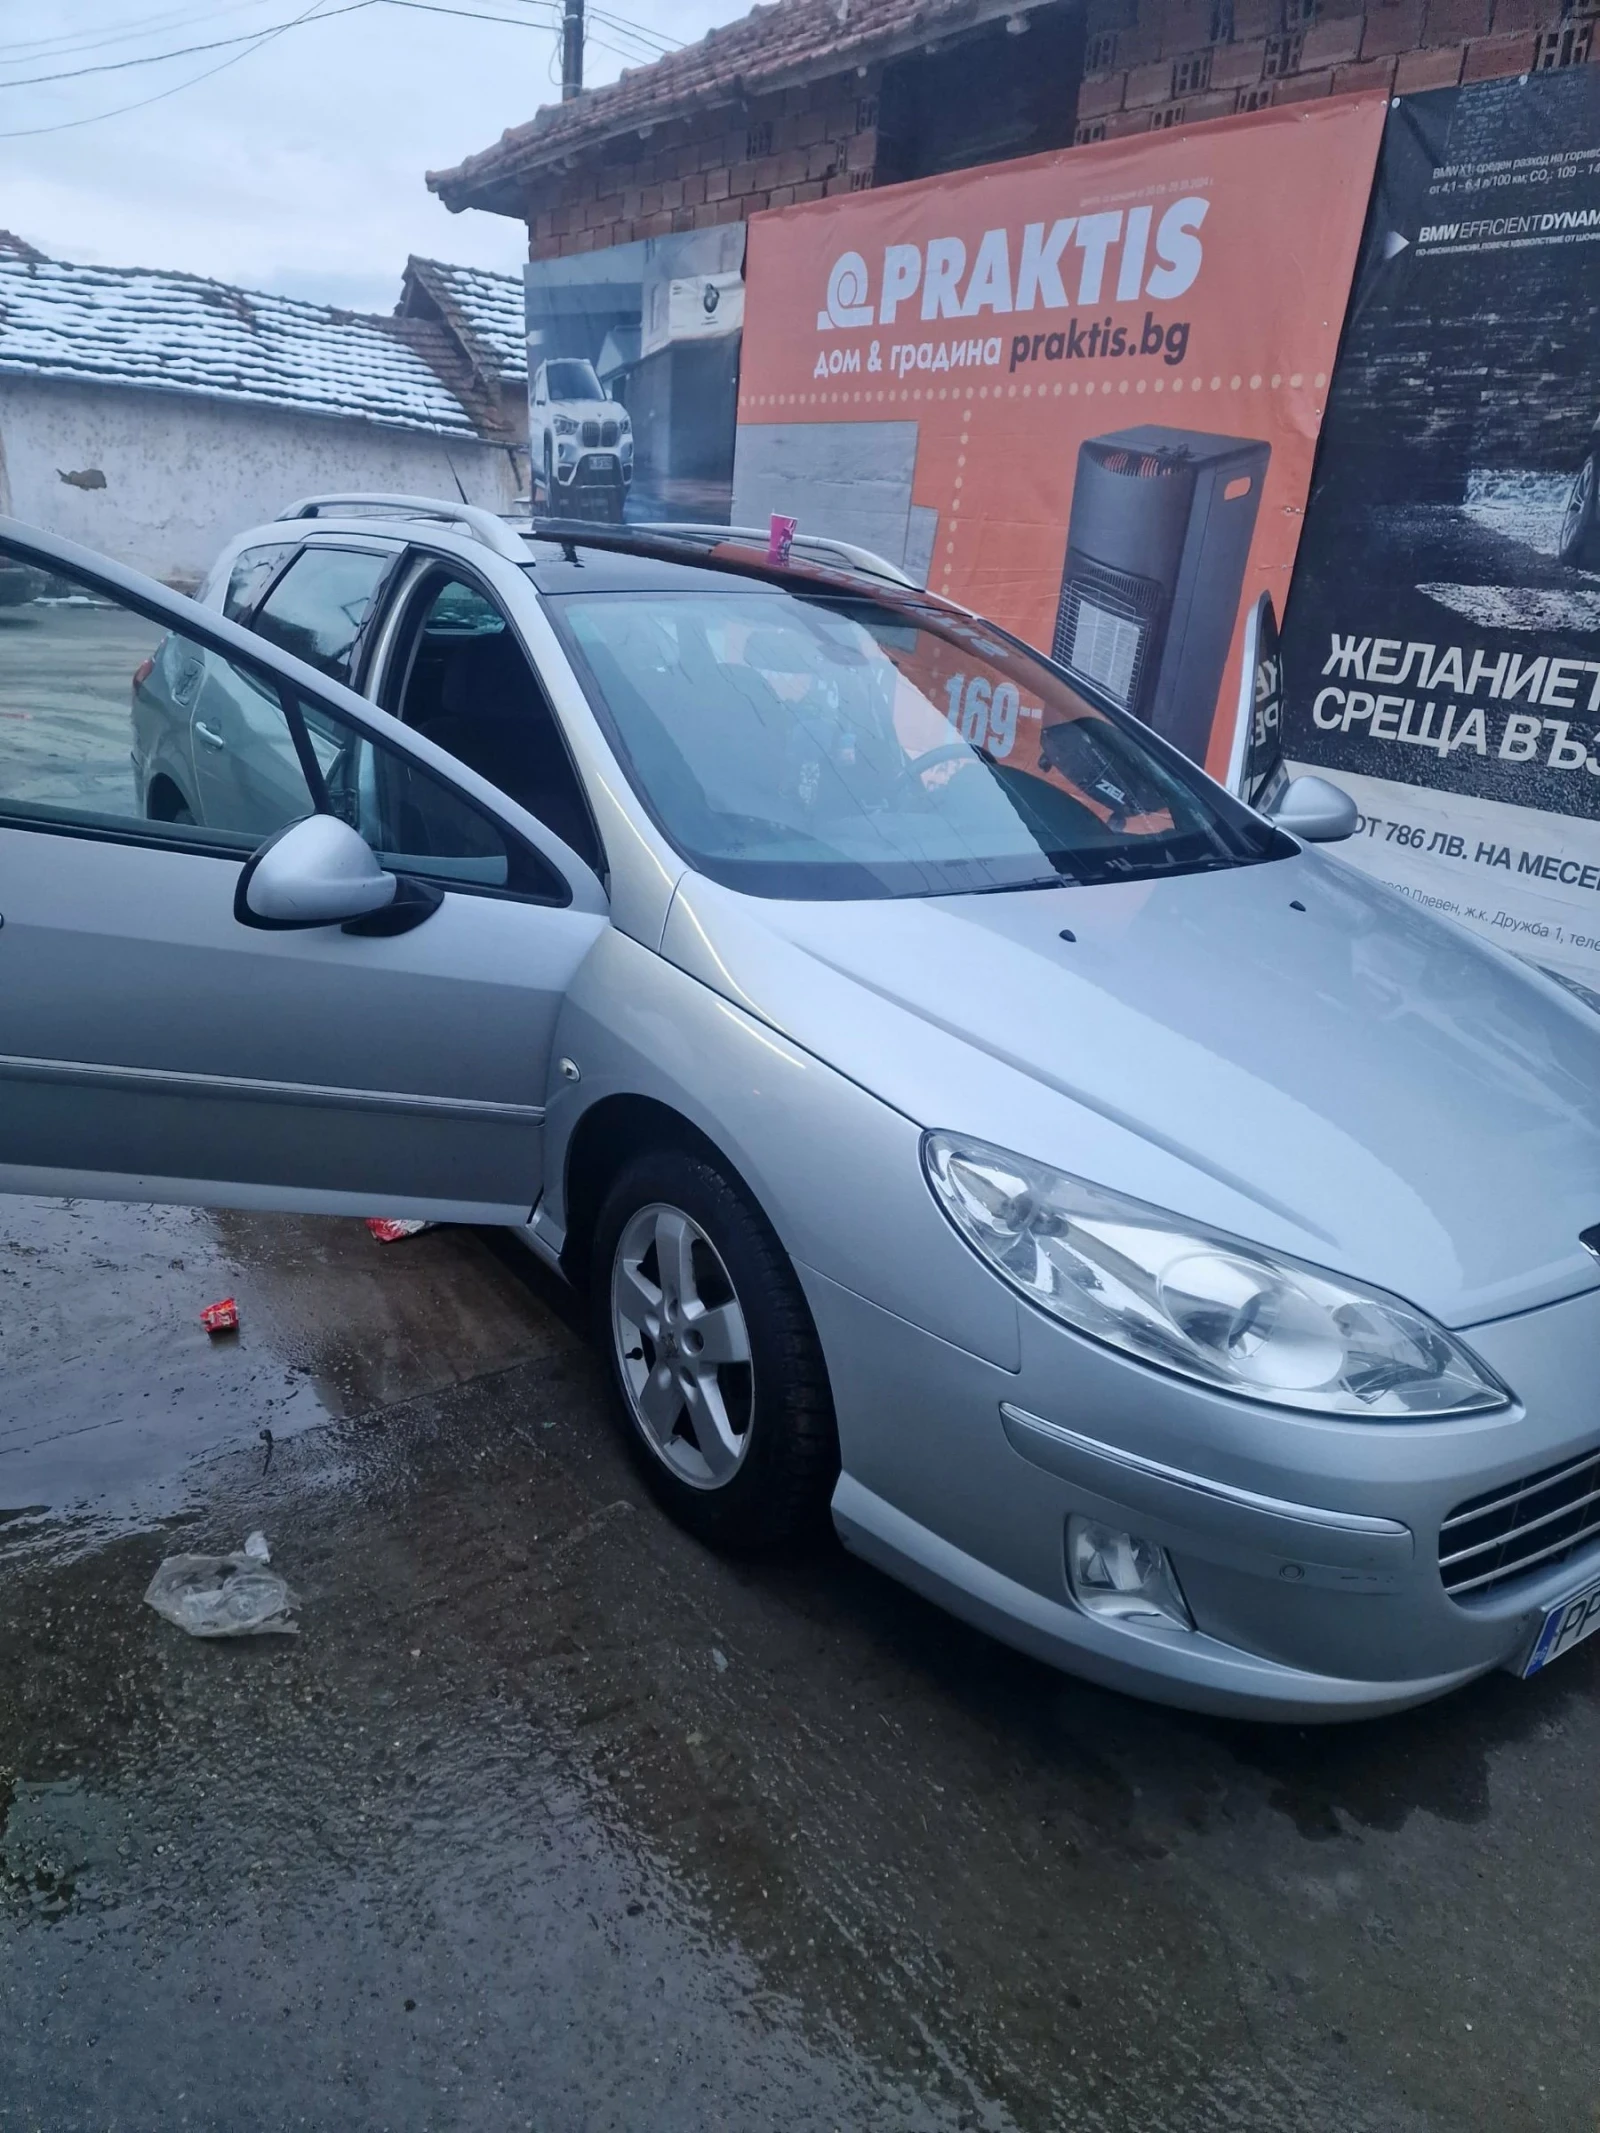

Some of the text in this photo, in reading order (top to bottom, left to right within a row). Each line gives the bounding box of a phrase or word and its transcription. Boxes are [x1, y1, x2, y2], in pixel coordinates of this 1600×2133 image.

[1550, 153, 1564, 163] на
[1557, 166, 1577, 178] 109
[878, 197, 1211, 324] PRAKTIS
[866, 343, 883, 372] &
[890, 336, 1001, 379] градина
[1009, 311, 1191, 373] praktis.bg
[1312, 687, 1487, 758] СРЕЩА
[1385, 821, 1426, 849] 786
[1426, 832, 1468, 860] ЛВ.
[1474, 841, 1511, 870] НА
[1464, 906, 1488, 922] ж.к.
[1491, 911, 1550, 938] Дружба
